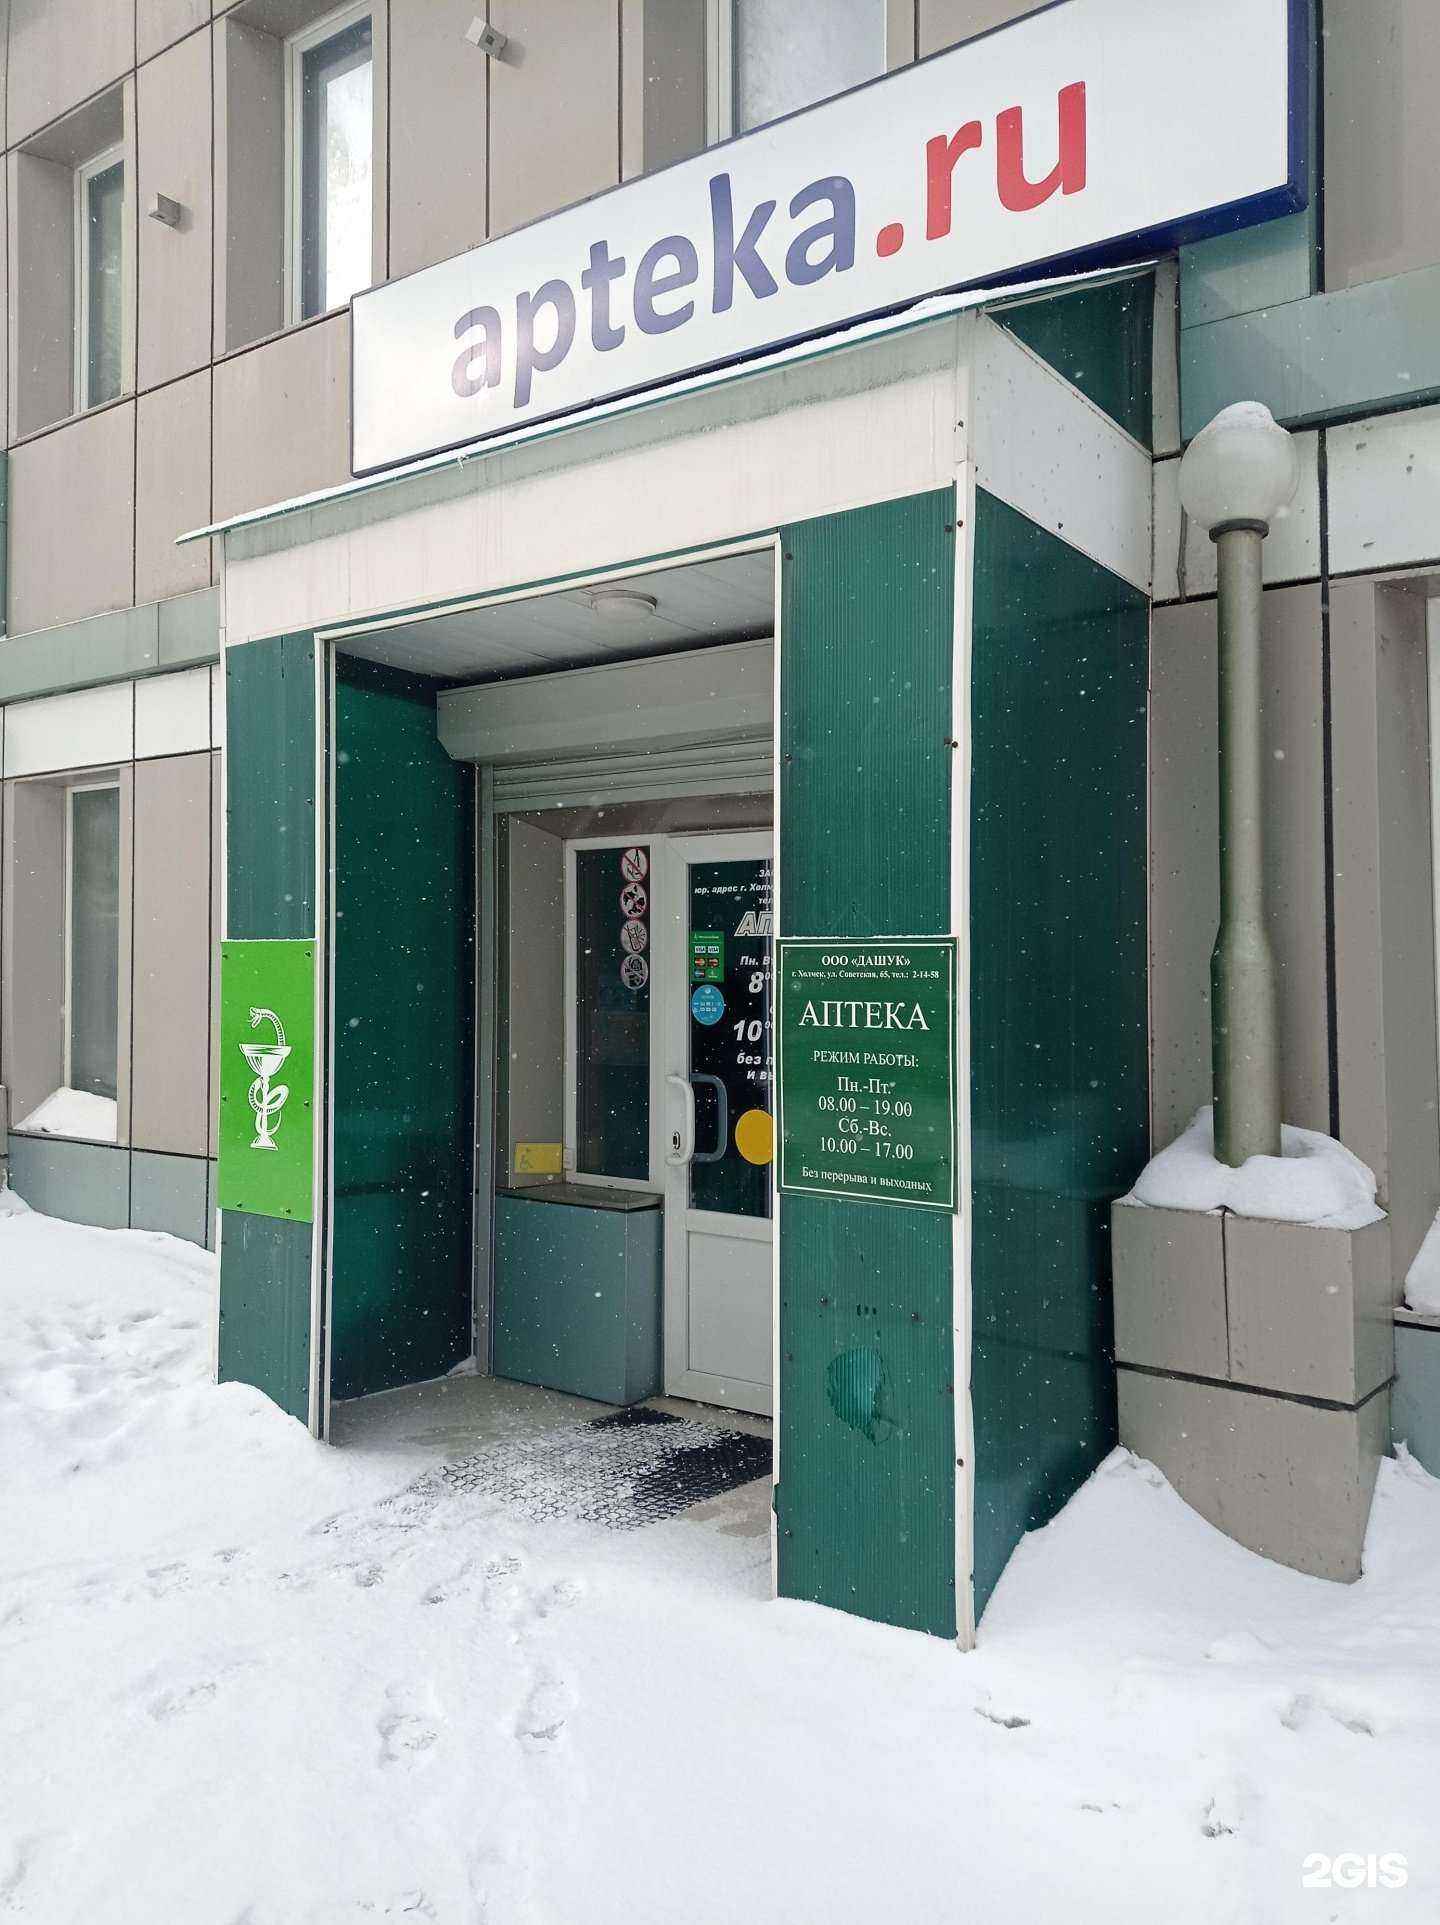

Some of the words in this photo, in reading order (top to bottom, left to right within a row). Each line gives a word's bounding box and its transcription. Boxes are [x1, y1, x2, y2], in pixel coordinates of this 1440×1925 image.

[451, 80, 1086, 408] apteka.ru
[712, 885, 738, 894] адрес
[740, 955, 759, 965] Пн.
[821, 955, 849, 966] ООО
[851, 955, 911, 967] «ДАШУК»
[912, 970, 940, 979] 2-14-58
[799, 1000, 930, 1030] АПТЕКА
[736, 1052, 761, 1064] без
[813, 1050, 860, 1064] РЕЖИМ
[864, 1052, 919, 1067] РАБОТЫ:
[747, 1071, 756, 1080] и
[837, 1076, 892, 1094] Пн.-Пт.
[818, 1096, 856, 1113] 08.00
[875, 1100, 912, 1117] 19.00
[838, 1117, 892, 1136] Сб.-Вс.
[821, 1137, 857, 1154] 10.00
[875, 1142, 913, 1159] 17.00
[802, 1167, 819, 1178] Без
[821, 1170, 867, 1184] перерыва
[870, 1177, 877, 1185] и
[880, 1178, 933, 1191] выходных
